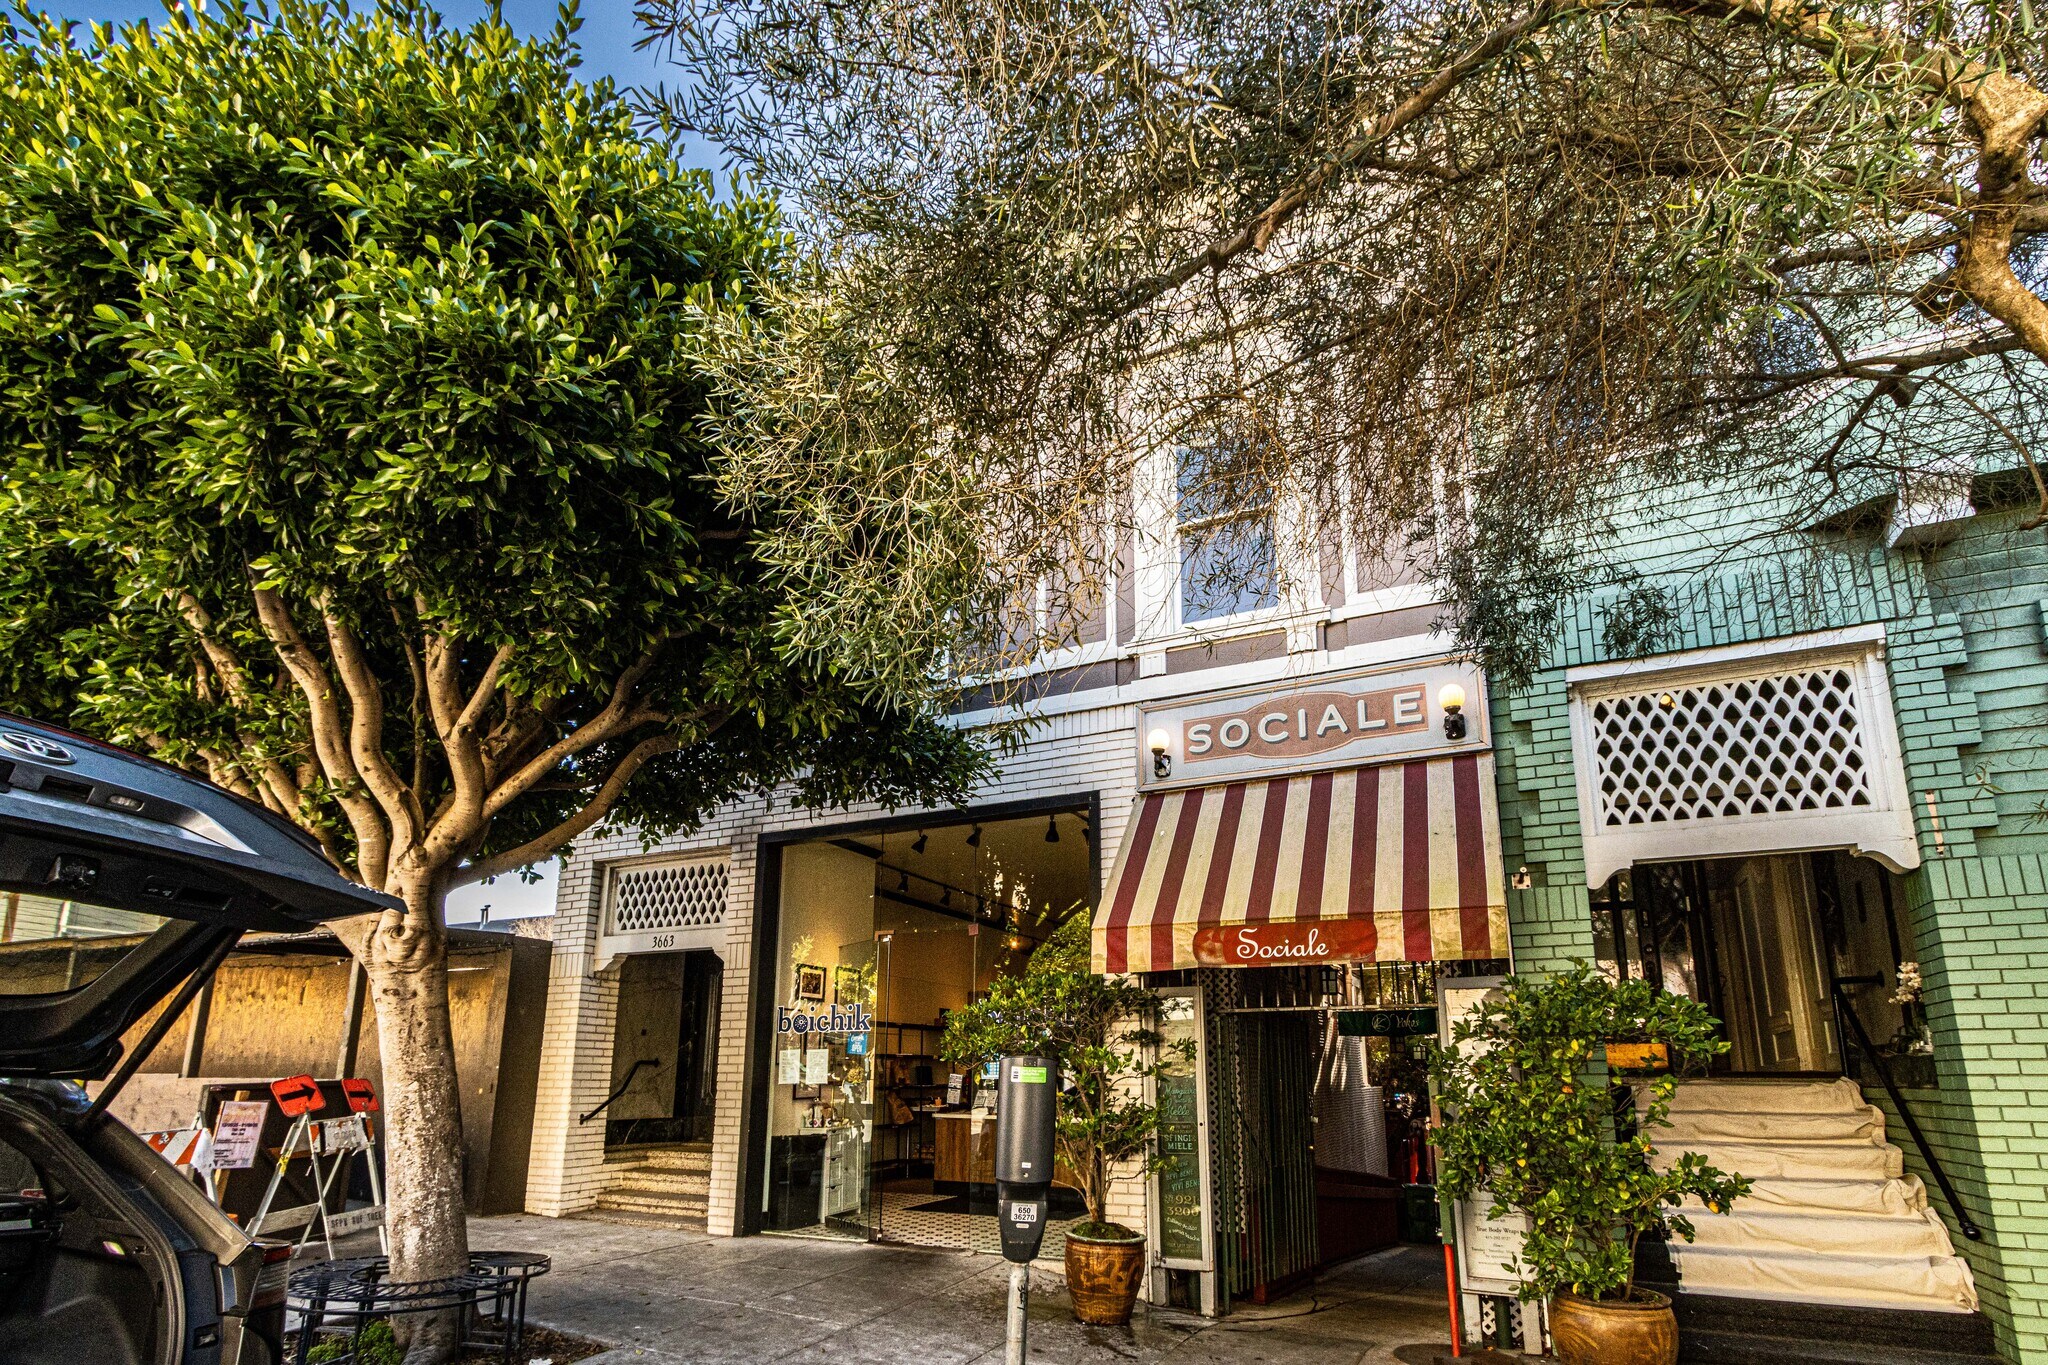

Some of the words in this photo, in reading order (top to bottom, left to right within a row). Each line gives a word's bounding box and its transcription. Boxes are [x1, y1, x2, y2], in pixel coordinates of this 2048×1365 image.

[1187, 690, 1424, 754] SOCIALE
[652, 935, 675, 949] 3663
[1236, 927, 1329, 959] Sociale
[777, 1003, 871, 1034] boichik
[1167, 1142, 1193, 1150] MIELE
[1013, 1213, 1035, 1221] 36270
[1166, 1206, 1199, 1217] 3200
[1502, 1227, 1520, 1235] Wraps
